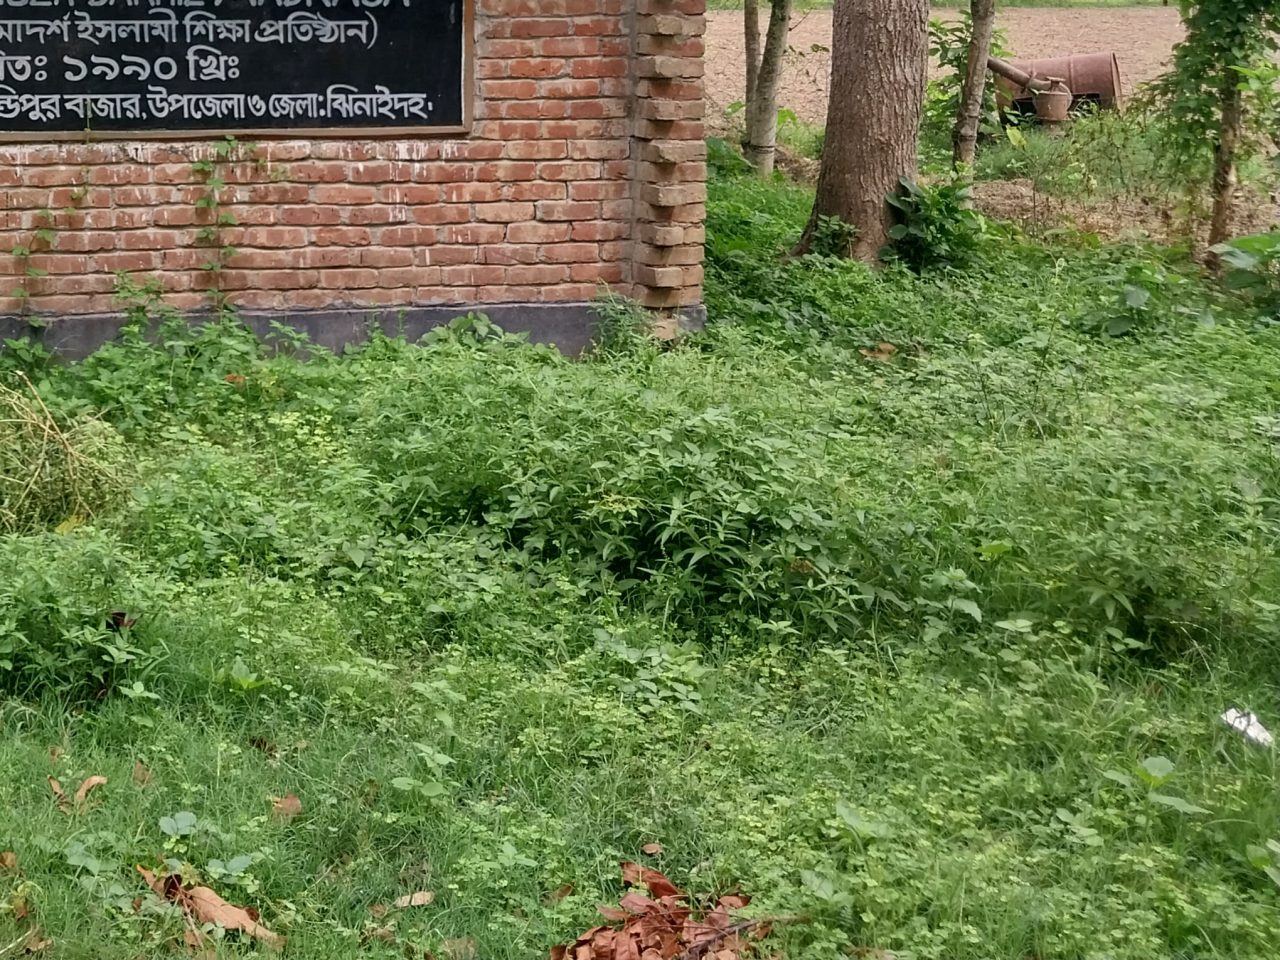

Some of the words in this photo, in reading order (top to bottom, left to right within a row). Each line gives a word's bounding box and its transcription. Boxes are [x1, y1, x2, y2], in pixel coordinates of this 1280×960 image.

[75, 8, 178, 45] ইসলামী
[183, 10, 251, 44] শিক্ষা
[254, 10, 379, 49] প্রতিষ্ঠান)
[62, 54, 178, 82] ১৯৯০
[147, 86, 246, 120] উপজেলা
[246, 96, 268, 117] ও
